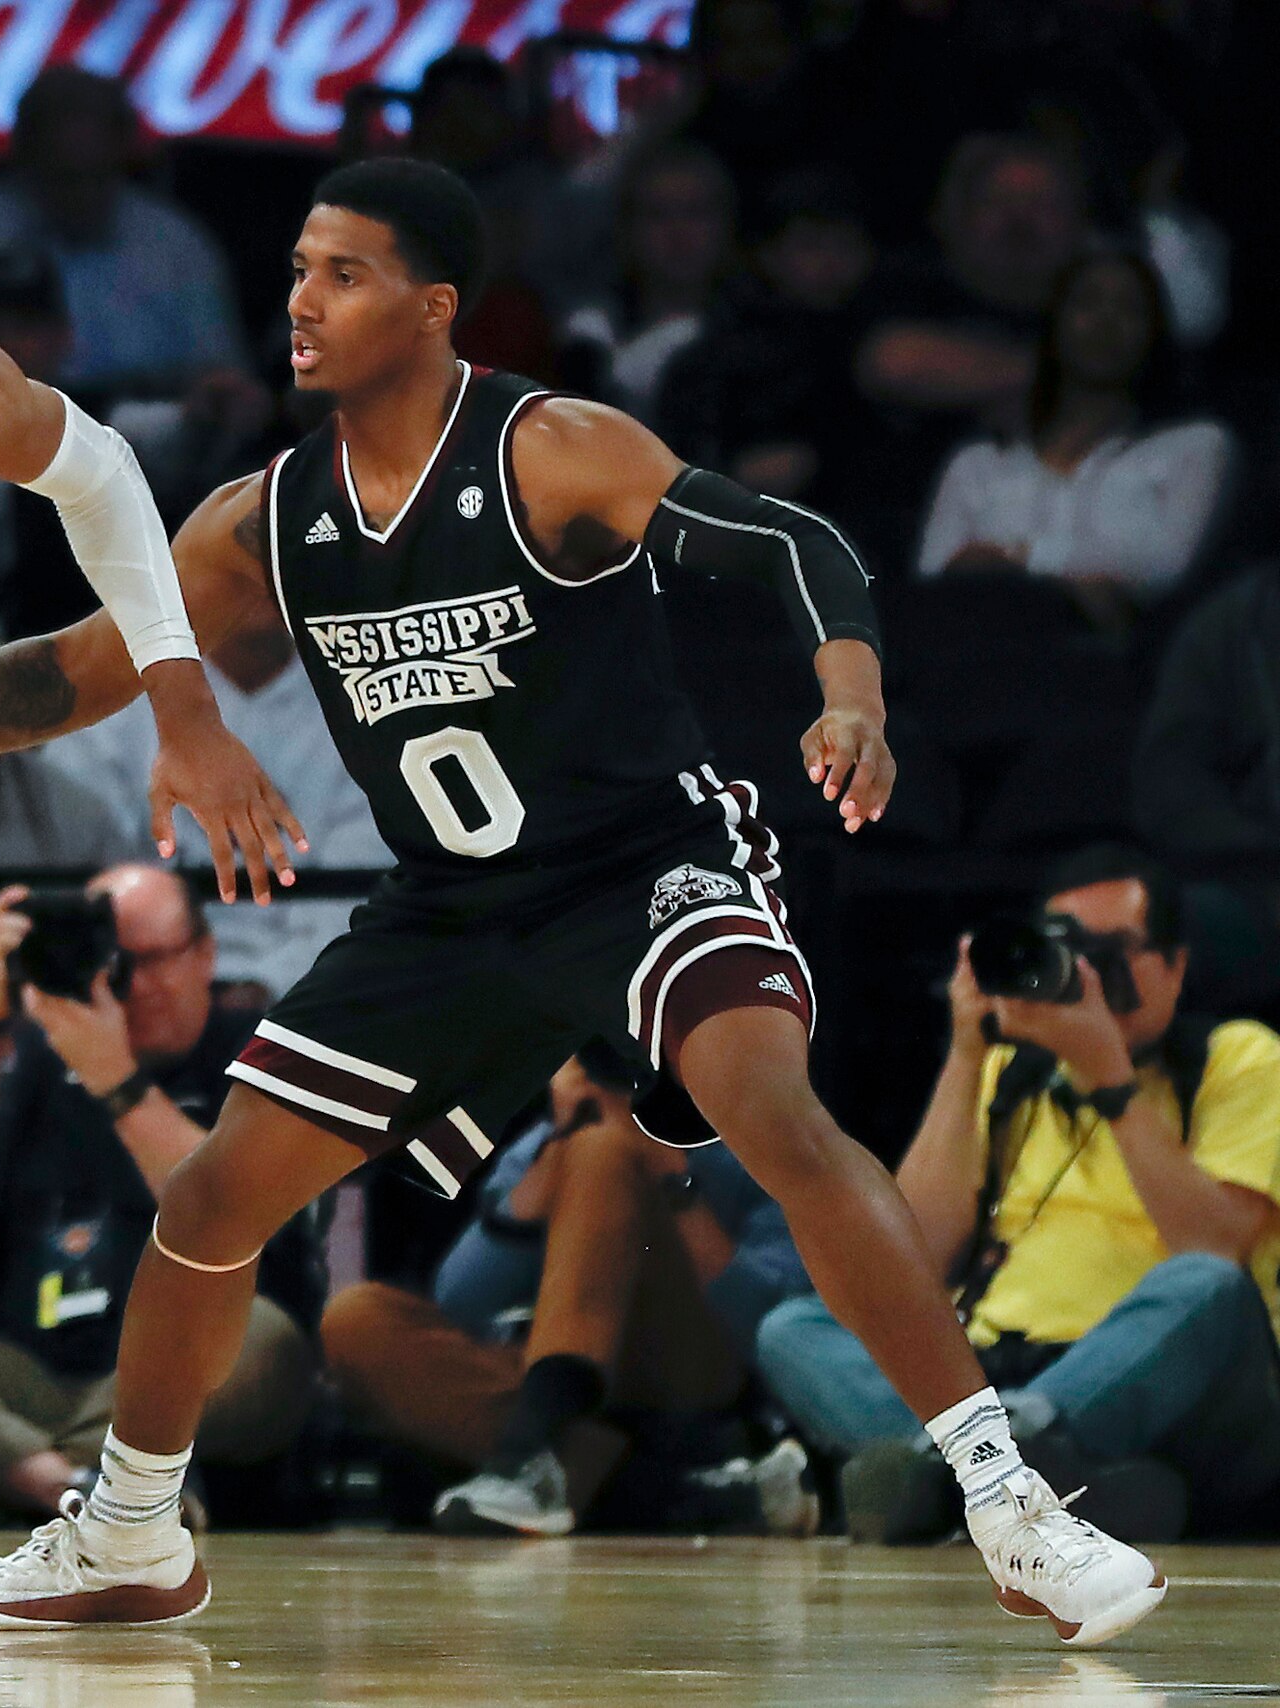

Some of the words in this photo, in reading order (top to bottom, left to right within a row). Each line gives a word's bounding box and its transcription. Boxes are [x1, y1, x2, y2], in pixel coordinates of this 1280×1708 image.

[365, 668, 476, 713] STATE
[399, 725, 527, 858] 0
[970, 1448, 1005, 1466] adidas
